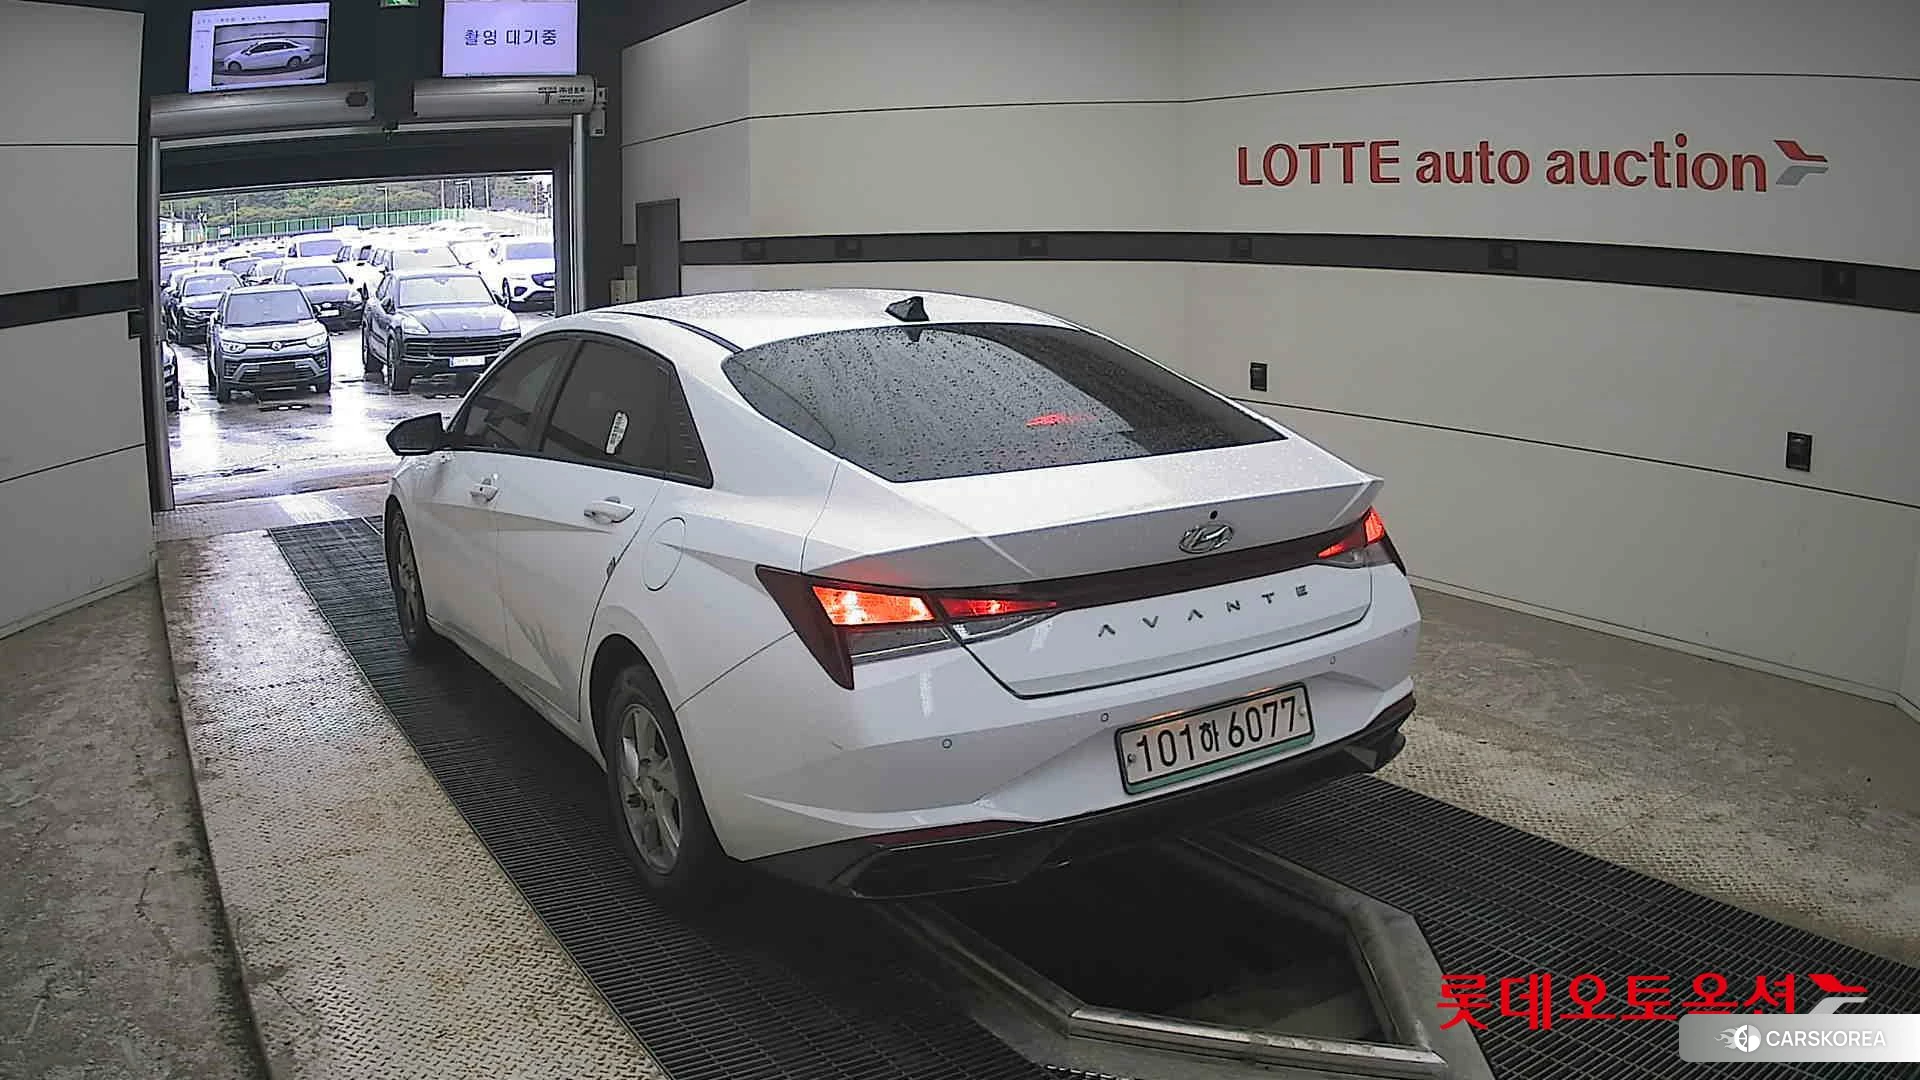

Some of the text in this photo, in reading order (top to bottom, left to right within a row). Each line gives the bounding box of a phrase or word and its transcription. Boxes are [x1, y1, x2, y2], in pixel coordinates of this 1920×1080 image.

[464, 29, 557, 46] 촬영 대기중
[1238, 133, 1768, 193] LOTTE auto auction
[1098, 584, 1309, 638] AVANTE
